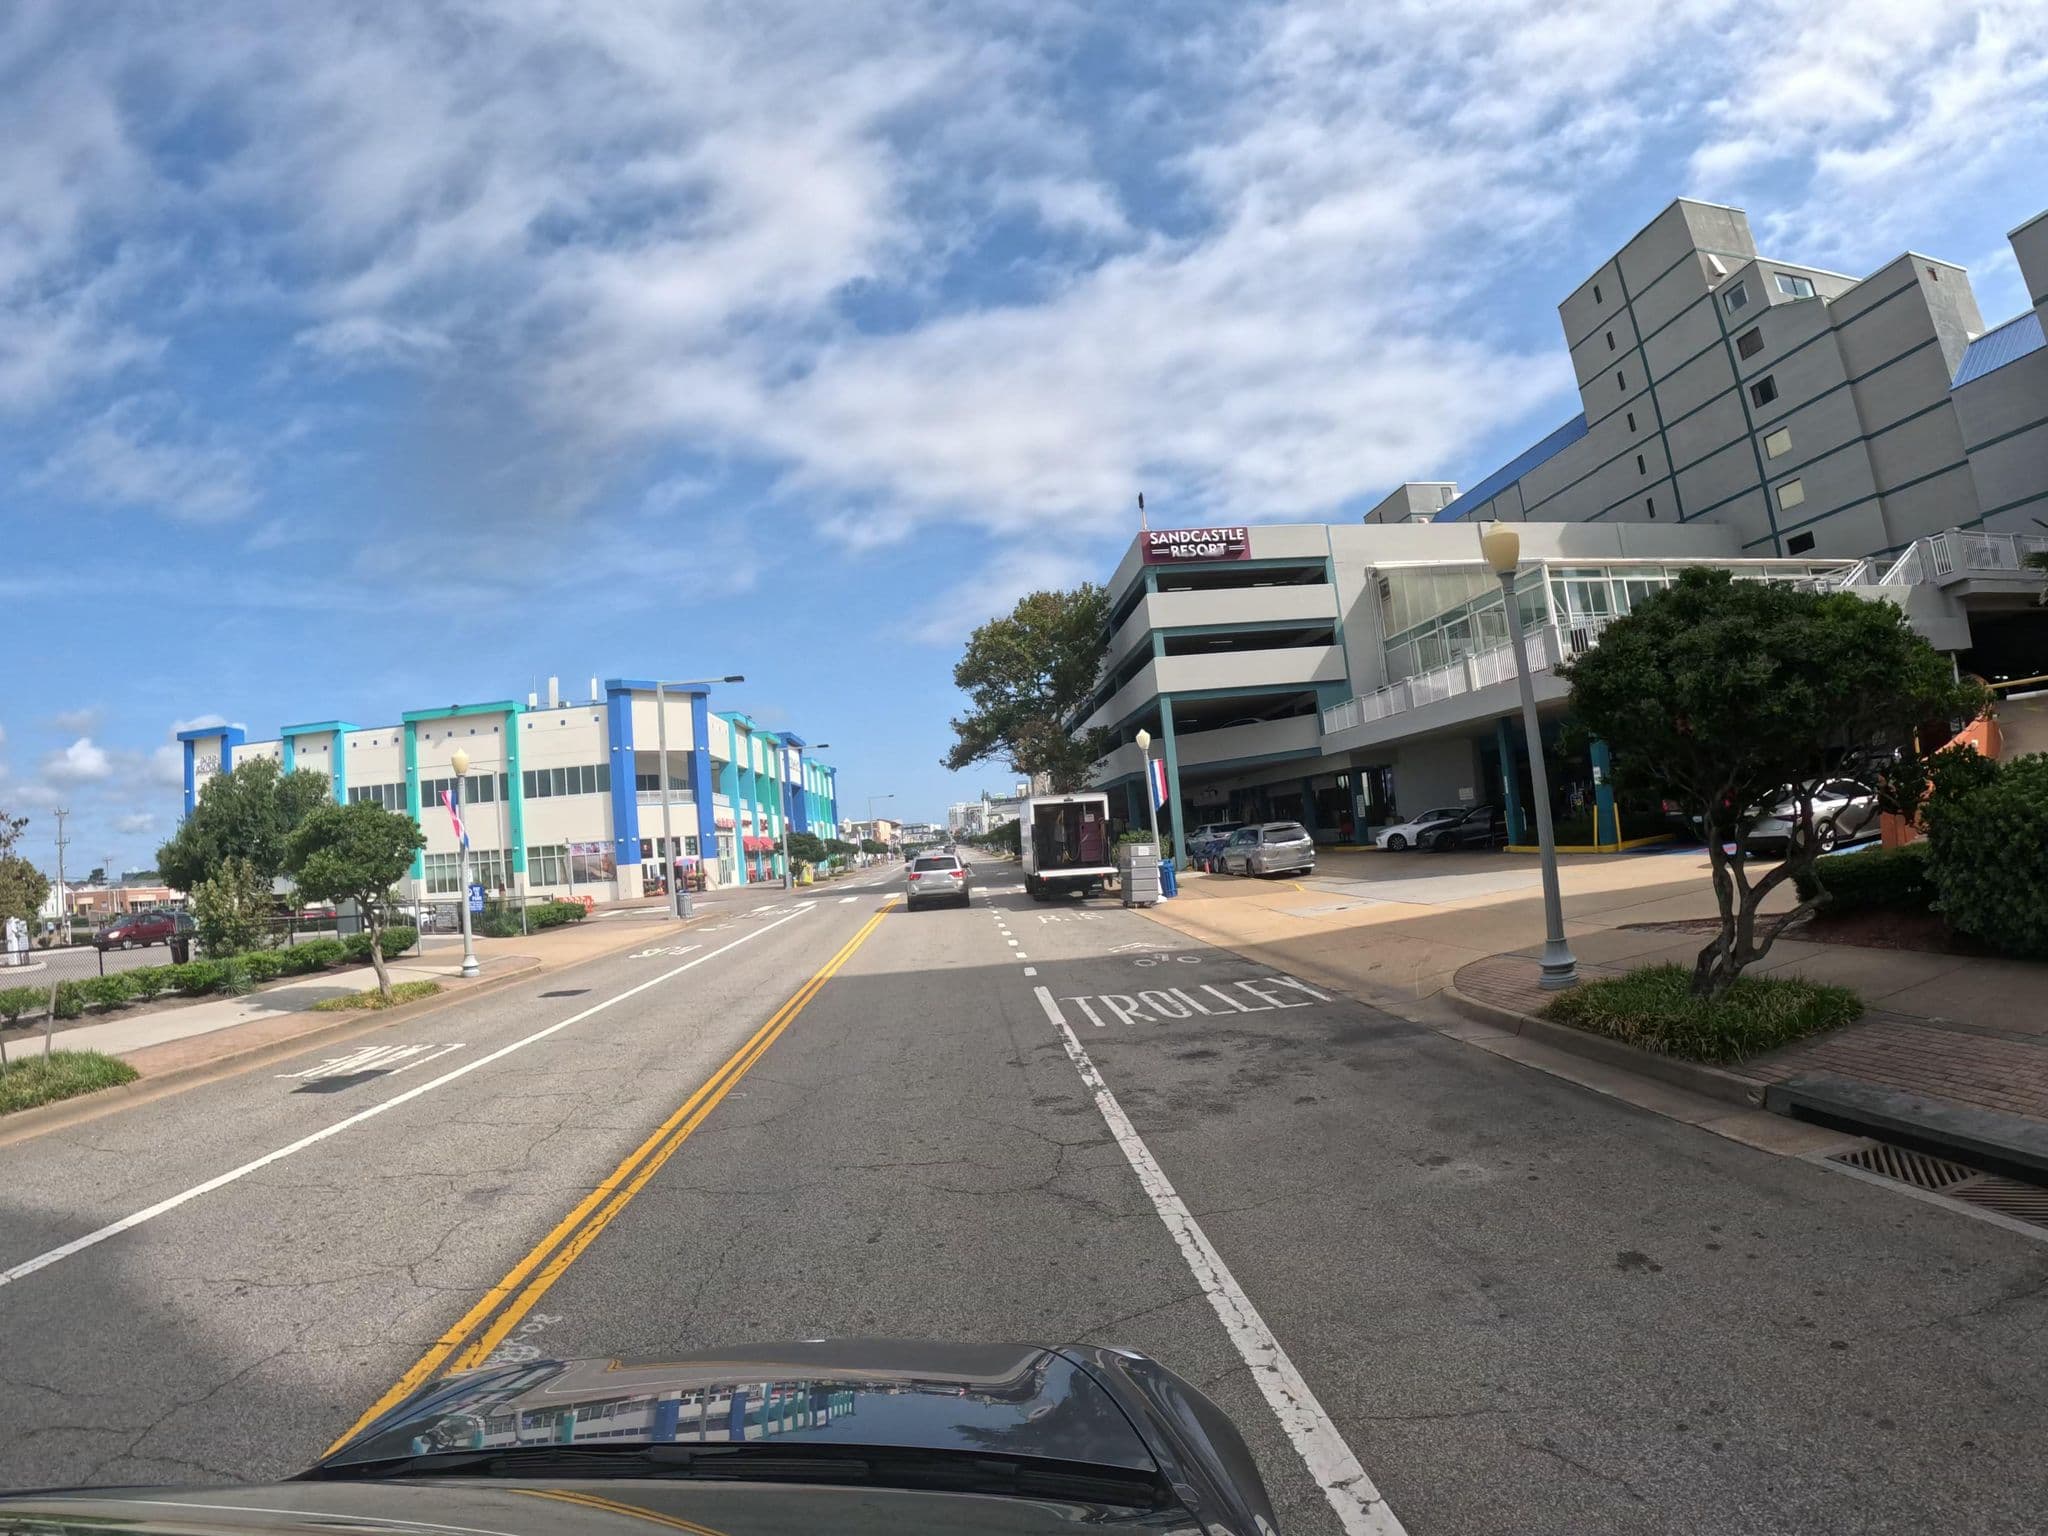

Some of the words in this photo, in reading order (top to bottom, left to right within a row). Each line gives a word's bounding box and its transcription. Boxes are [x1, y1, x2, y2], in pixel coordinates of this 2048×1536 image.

[1150, 529, 1245, 545] SANDCASTLE
[1170, 543, 1227, 557] RESORT
[1059, 976, 1334, 1027] TROLLEY
